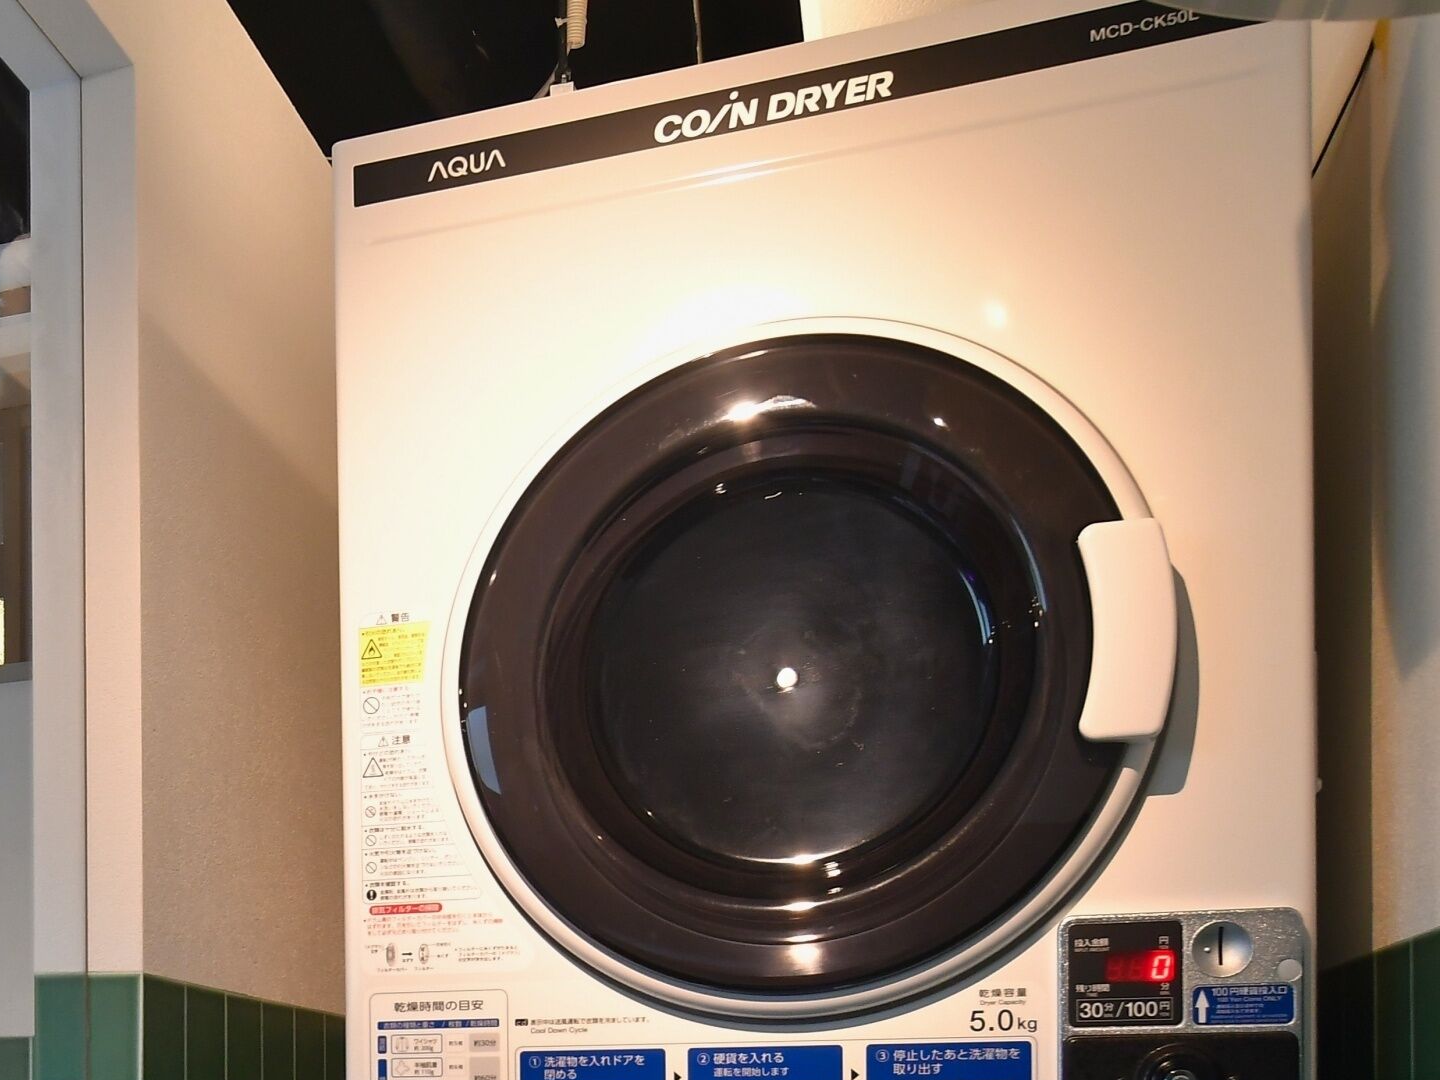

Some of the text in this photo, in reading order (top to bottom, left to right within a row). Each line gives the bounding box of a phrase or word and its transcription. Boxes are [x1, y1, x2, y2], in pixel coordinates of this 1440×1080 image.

[766, 70, 894, 121] DRYER
[427, 149, 506, 182] AQUA
[391, 612, 410, 622] 警告
[391, 734, 411, 745] 注意
[1159, 936, 1169, 944] 円
[1151, 955, 1171, 979] 0
[1160, 982, 1170, 990] 分
[979, 988, 1026, 998] 乾燥容量
[394, 1000, 484, 1012] 乾燥時間の目安
[970, 1009, 1037, 1033] 5.0 kg
[714, 1052, 784, 1064] 硬貨を入れる
[893, 1048, 1020, 1061] 停止したあと洗濯物を
[544, 1055, 645, 1067] 洗濯物を入れドアを
[544, 1069, 577, 1080] 閉める
[714, 1067, 789, 1077] 運転を開始します
[893, 1063, 943, 1075] 取り出す
